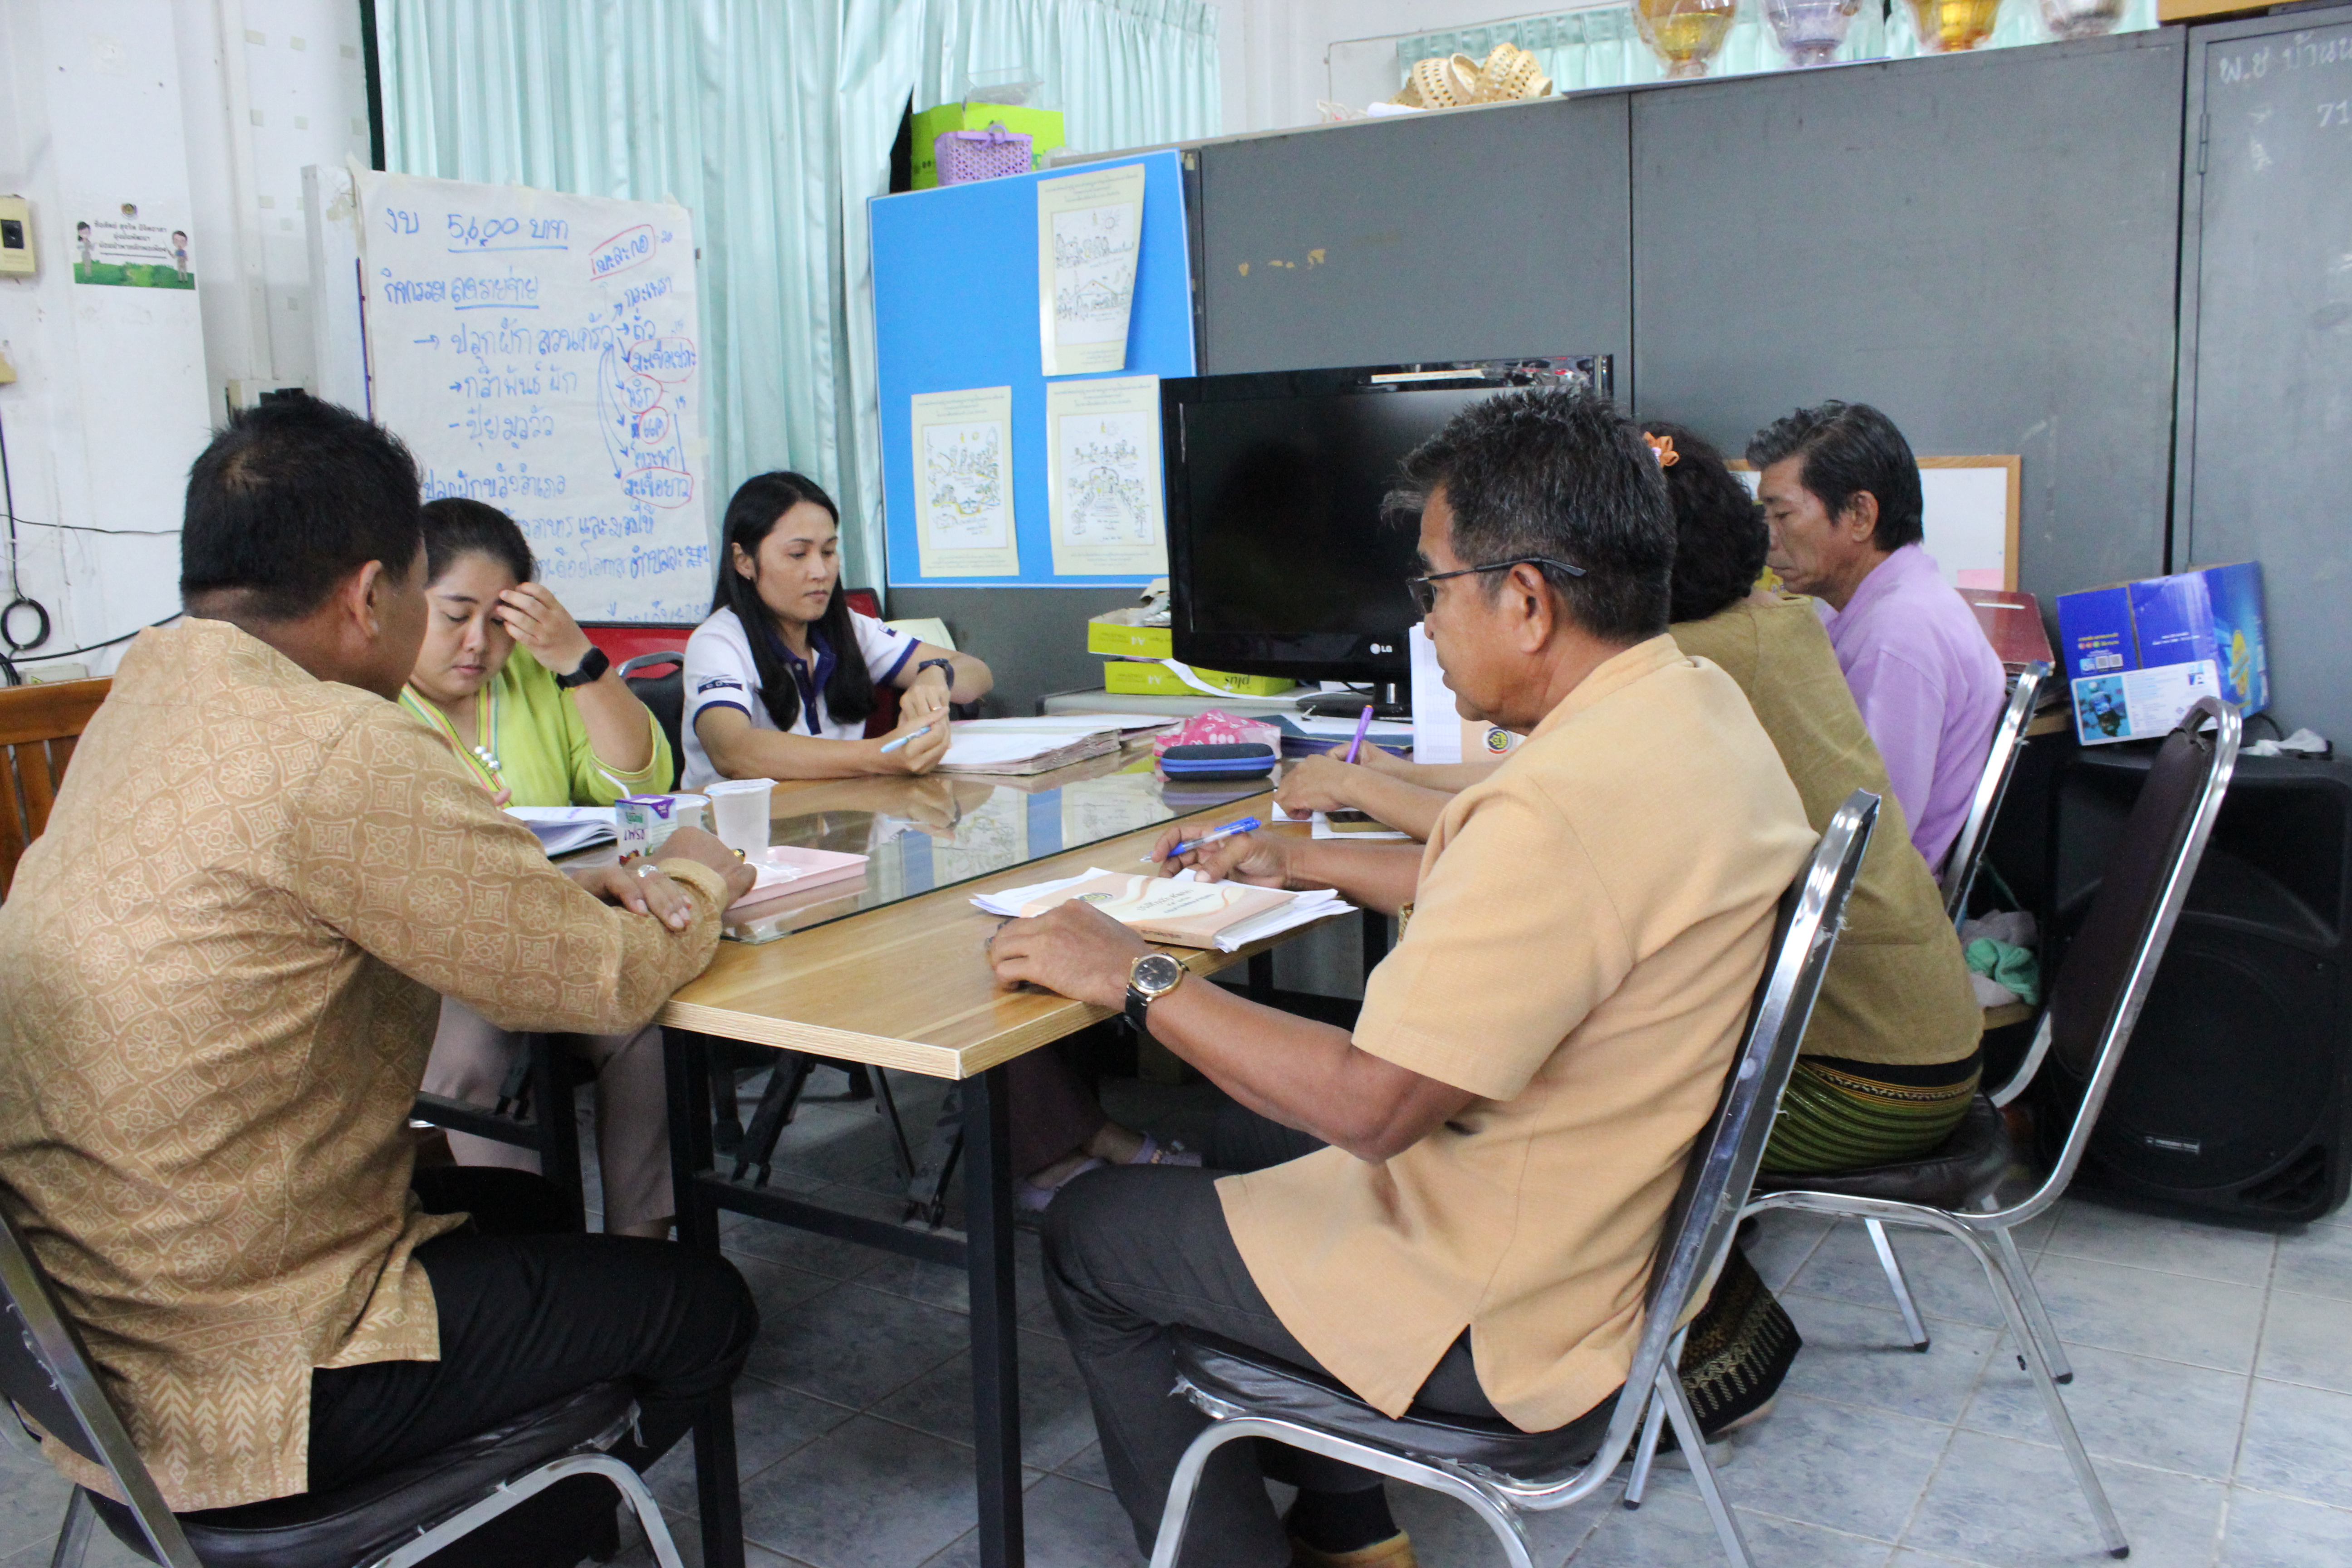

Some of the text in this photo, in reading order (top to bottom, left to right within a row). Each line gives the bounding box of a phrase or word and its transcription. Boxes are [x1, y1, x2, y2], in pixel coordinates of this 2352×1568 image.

[385, 208, 419, 234] งบ
[529, 218, 569, 240] บาท
[1131, 636, 1146, 646] A4
[1148, 675, 1162, 684] A4
[1224, 674, 1250, 689] plus
